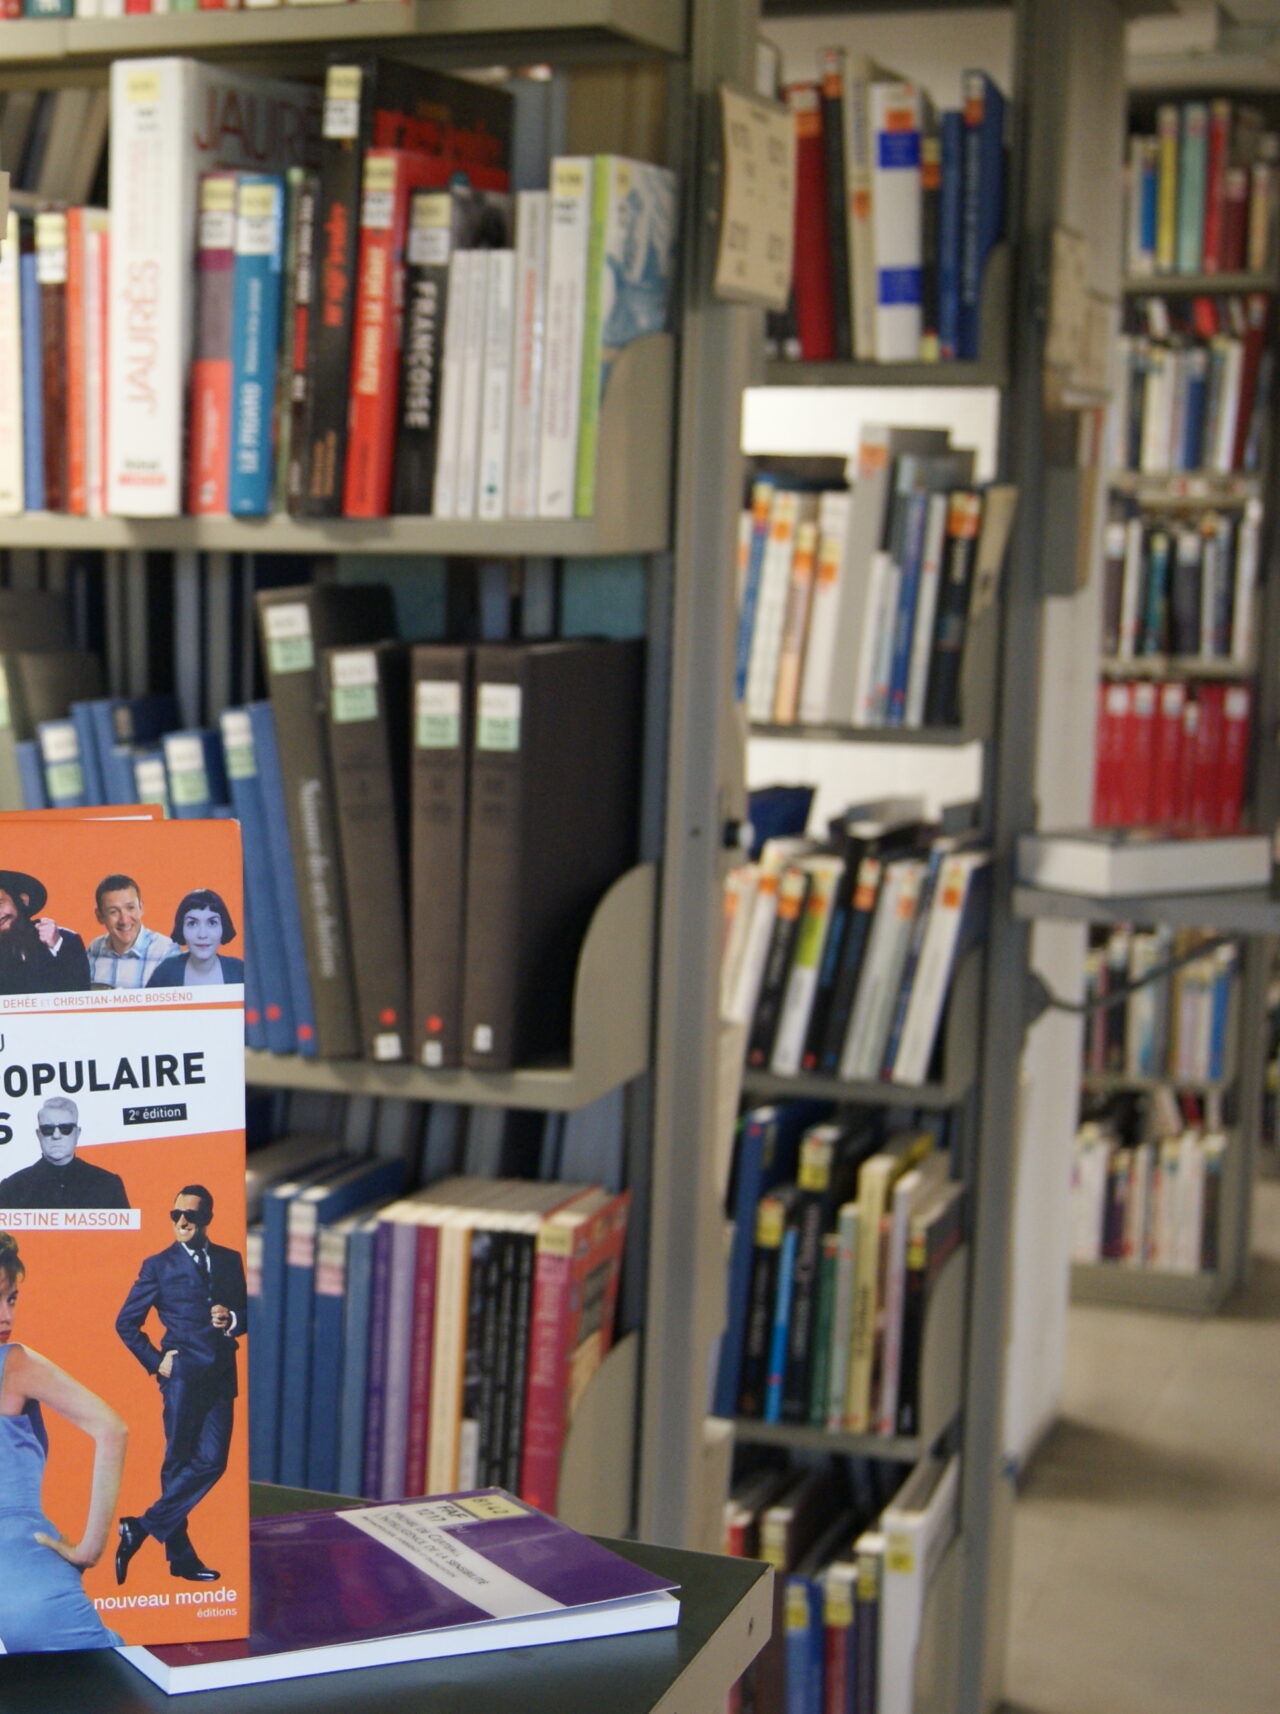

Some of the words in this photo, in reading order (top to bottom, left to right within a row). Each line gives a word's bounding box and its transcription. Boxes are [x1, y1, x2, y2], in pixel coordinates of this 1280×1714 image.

[3, 997, 37, 1009] DEHÉE
[53, 993, 142, 1007] CHRISTIAN-MARC
[145, 991, 193, 1004] BOSSÉNO
[142, 1106, 182, 1121] édition
[64, 1211, 131, 1226] MASSON
[93, 1593, 170, 1610] nouveau
[175, 1587, 237, 1605] monde
[196, 1606, 238, 1618] éditions
